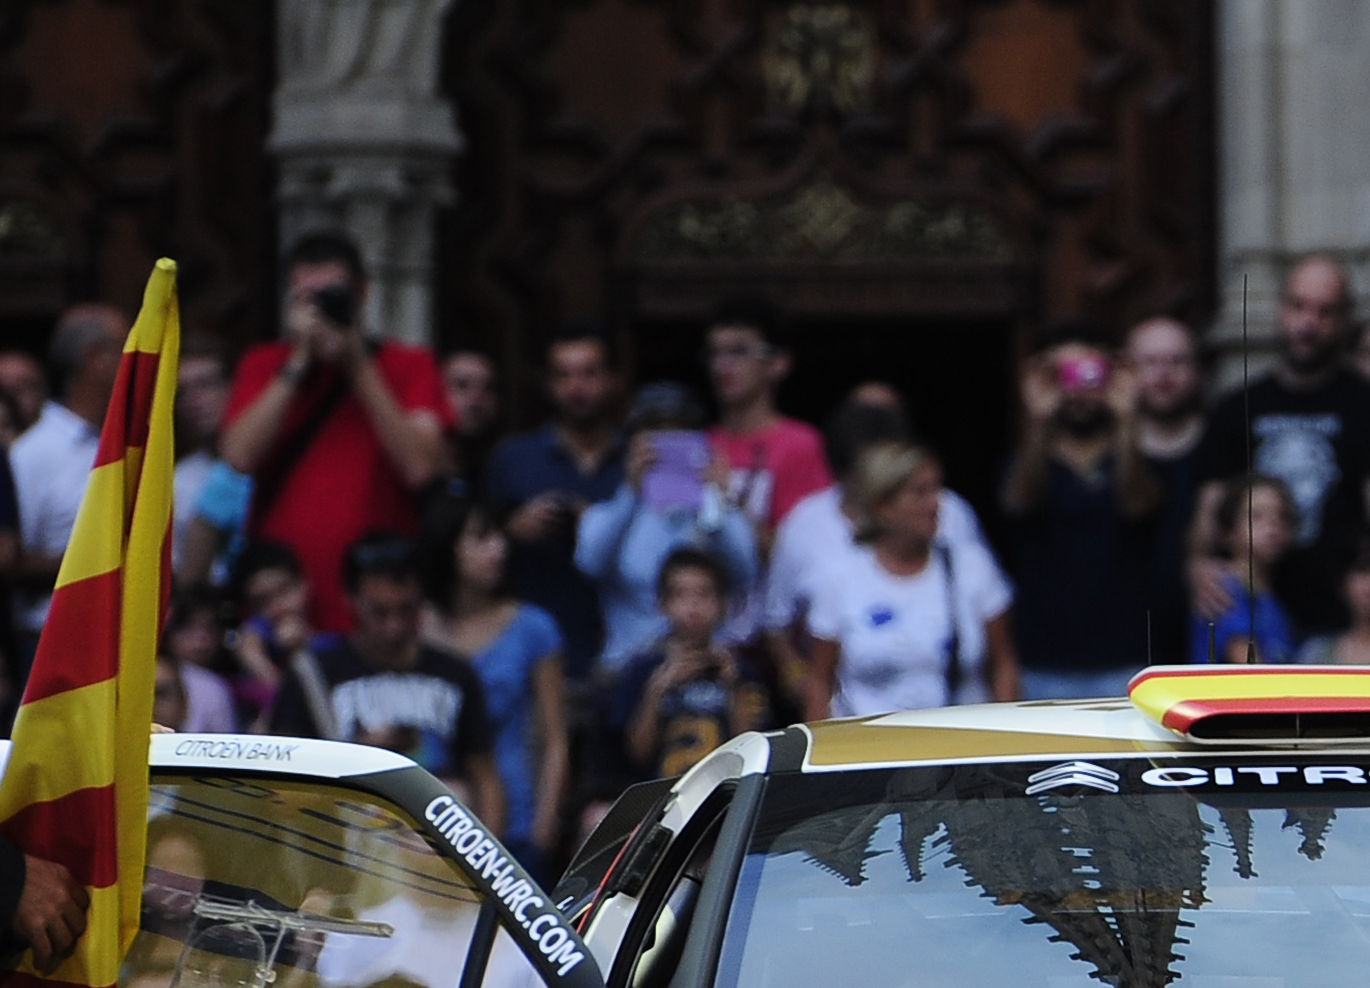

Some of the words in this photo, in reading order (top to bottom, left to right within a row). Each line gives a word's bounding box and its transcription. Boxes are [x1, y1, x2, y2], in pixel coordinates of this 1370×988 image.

[175, 738, 250, 761] CITROËN
[247, 743, 300, 762] BANK
[424, 795, 586, 978] CITROEN-WRC.COM
